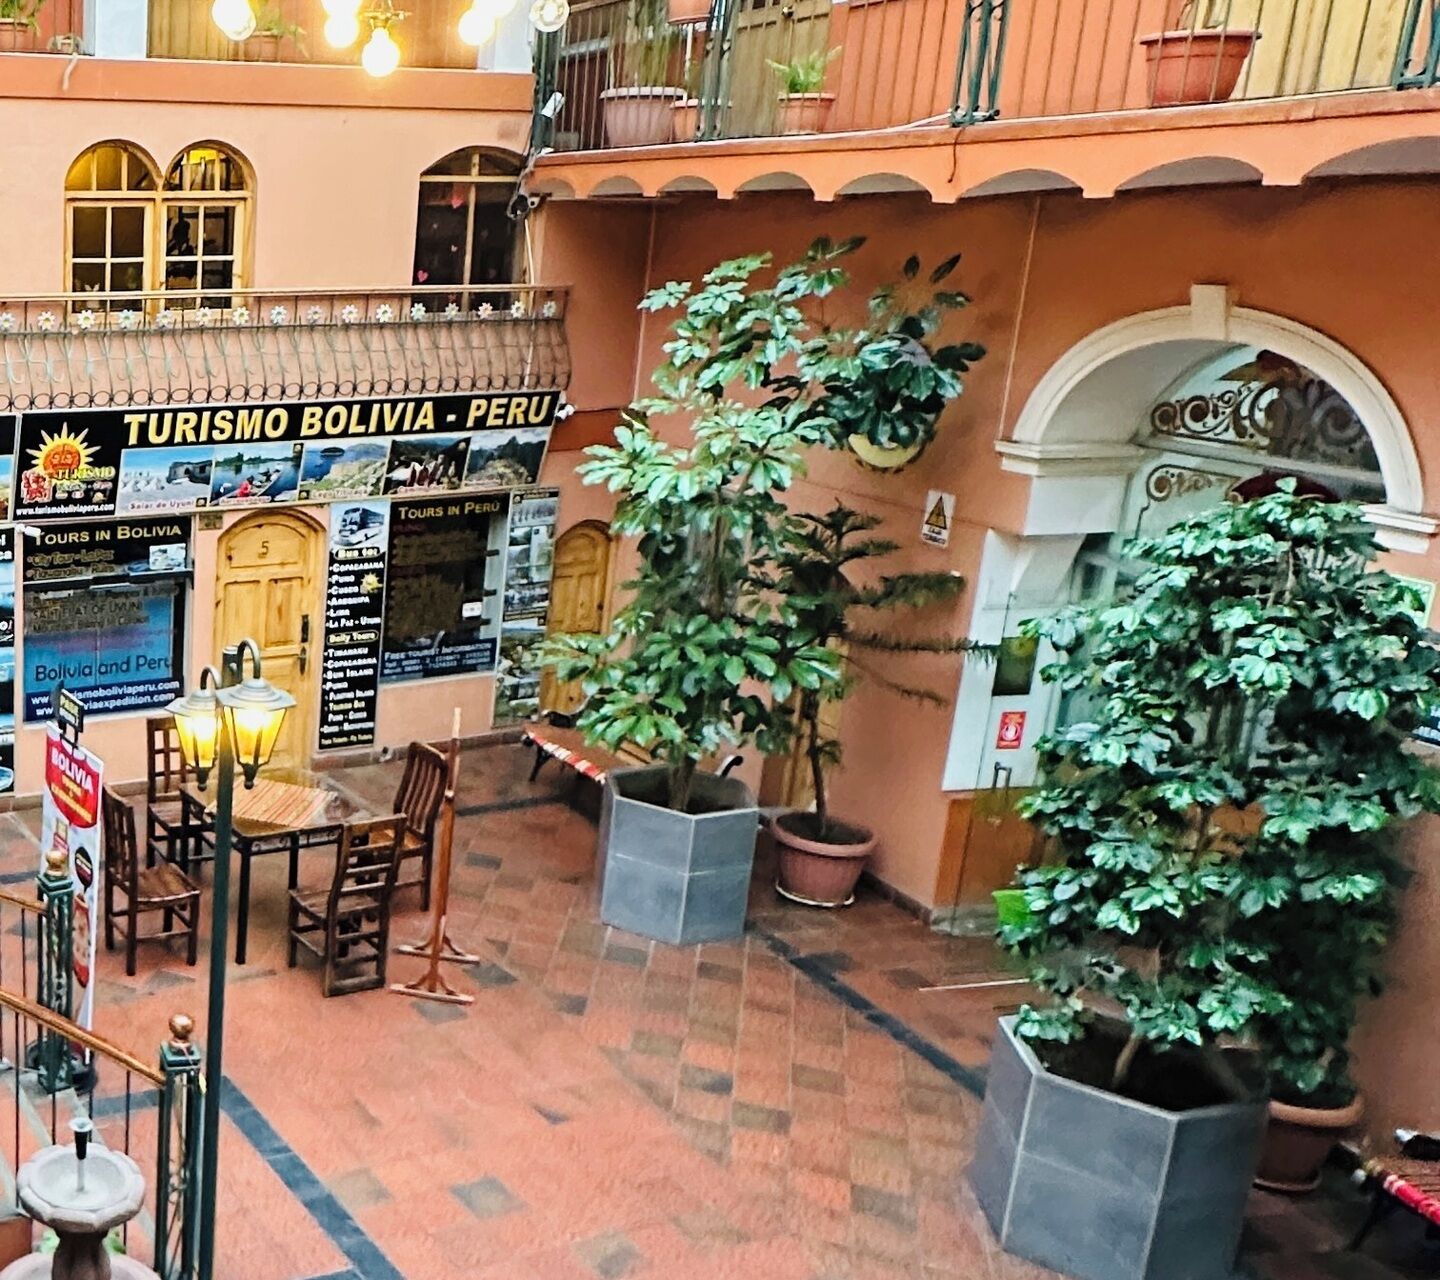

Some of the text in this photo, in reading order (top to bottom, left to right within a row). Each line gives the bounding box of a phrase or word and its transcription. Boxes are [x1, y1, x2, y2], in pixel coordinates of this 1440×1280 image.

[123, 408, 287, 446] TURISMO
[300, 400, 435, 438] BOLIVIA
[467, 396, 551, 428] PERU
[399, 506, 443, 519] TOURS
[448, 505, 460, 516] IN
[34, 525, 182, 546] TOURS IN BOLIVIA
[258, 540, 269, 558] 5
[35, 660, 92, 682] Bolivia
[98, 656, 131, 675] and
[51, 746, 94, 794] BOLIVIA
